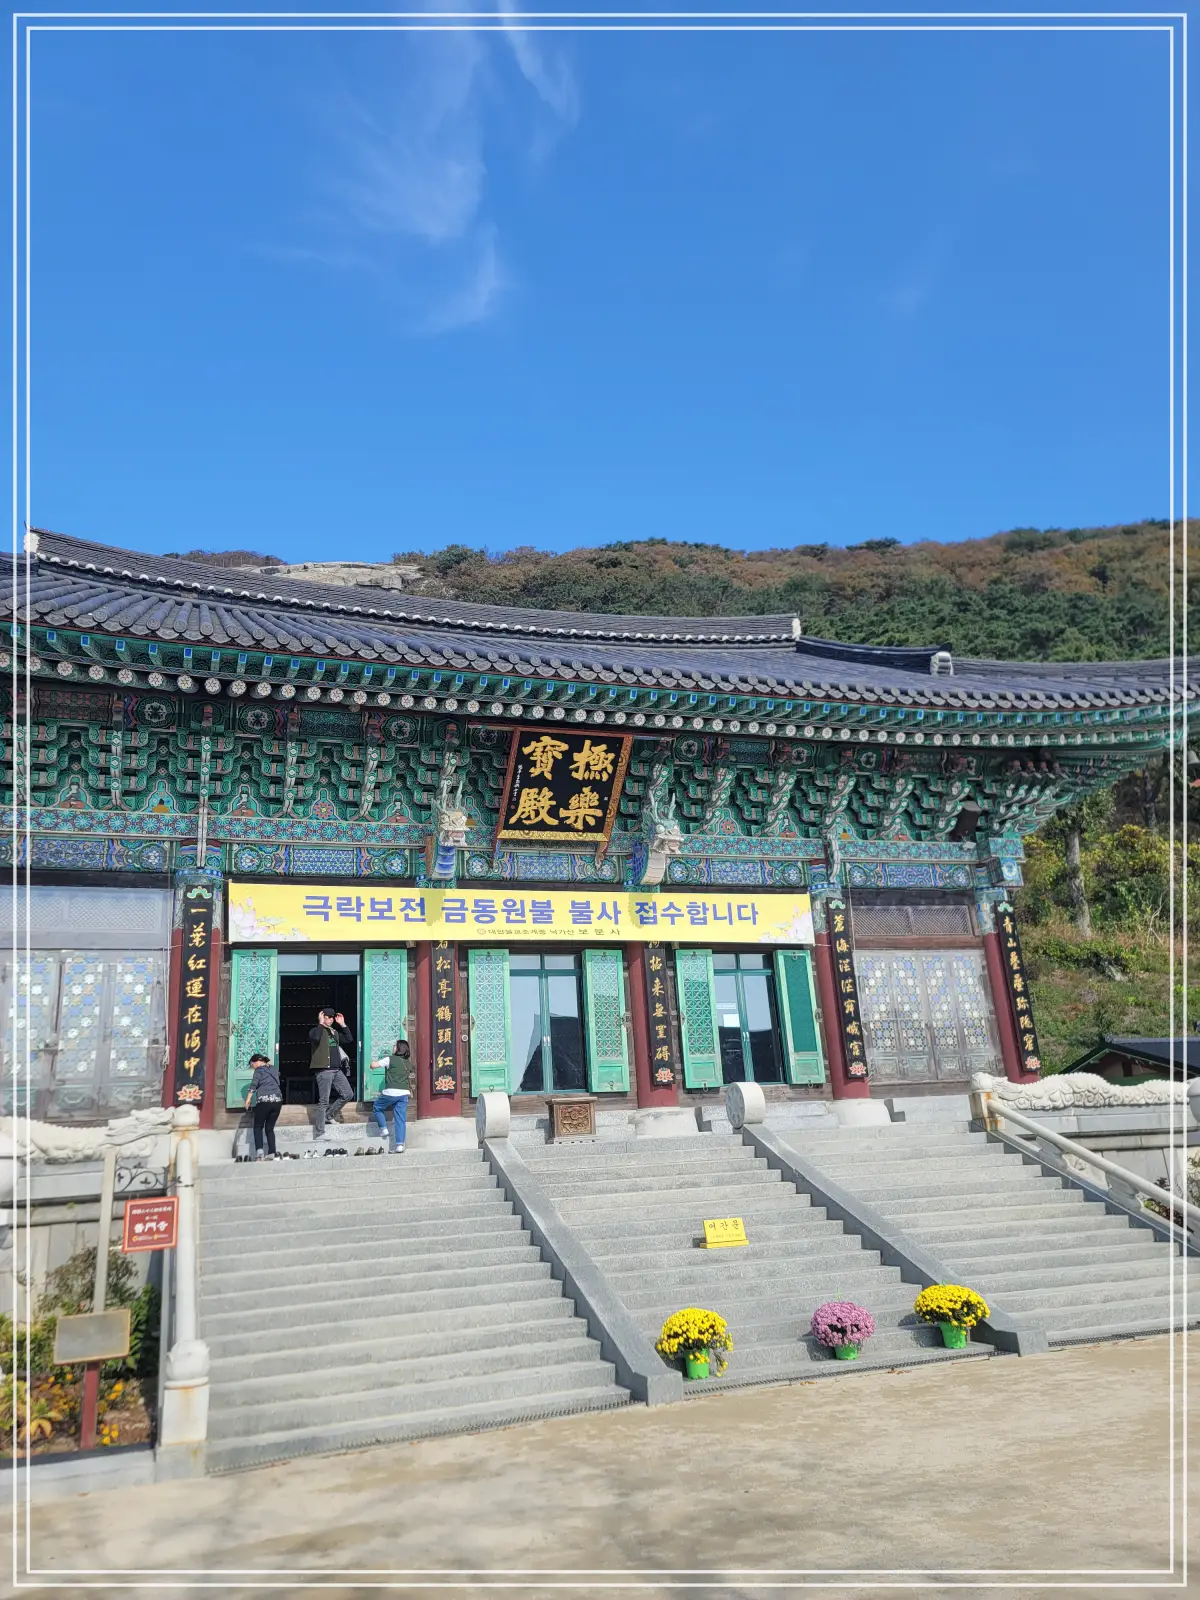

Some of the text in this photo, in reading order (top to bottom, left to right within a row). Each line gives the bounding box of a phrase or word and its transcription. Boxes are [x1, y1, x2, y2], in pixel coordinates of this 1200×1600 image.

[302, 895, 759, 926] 극락보전 금동원불 불사 접수합니다
